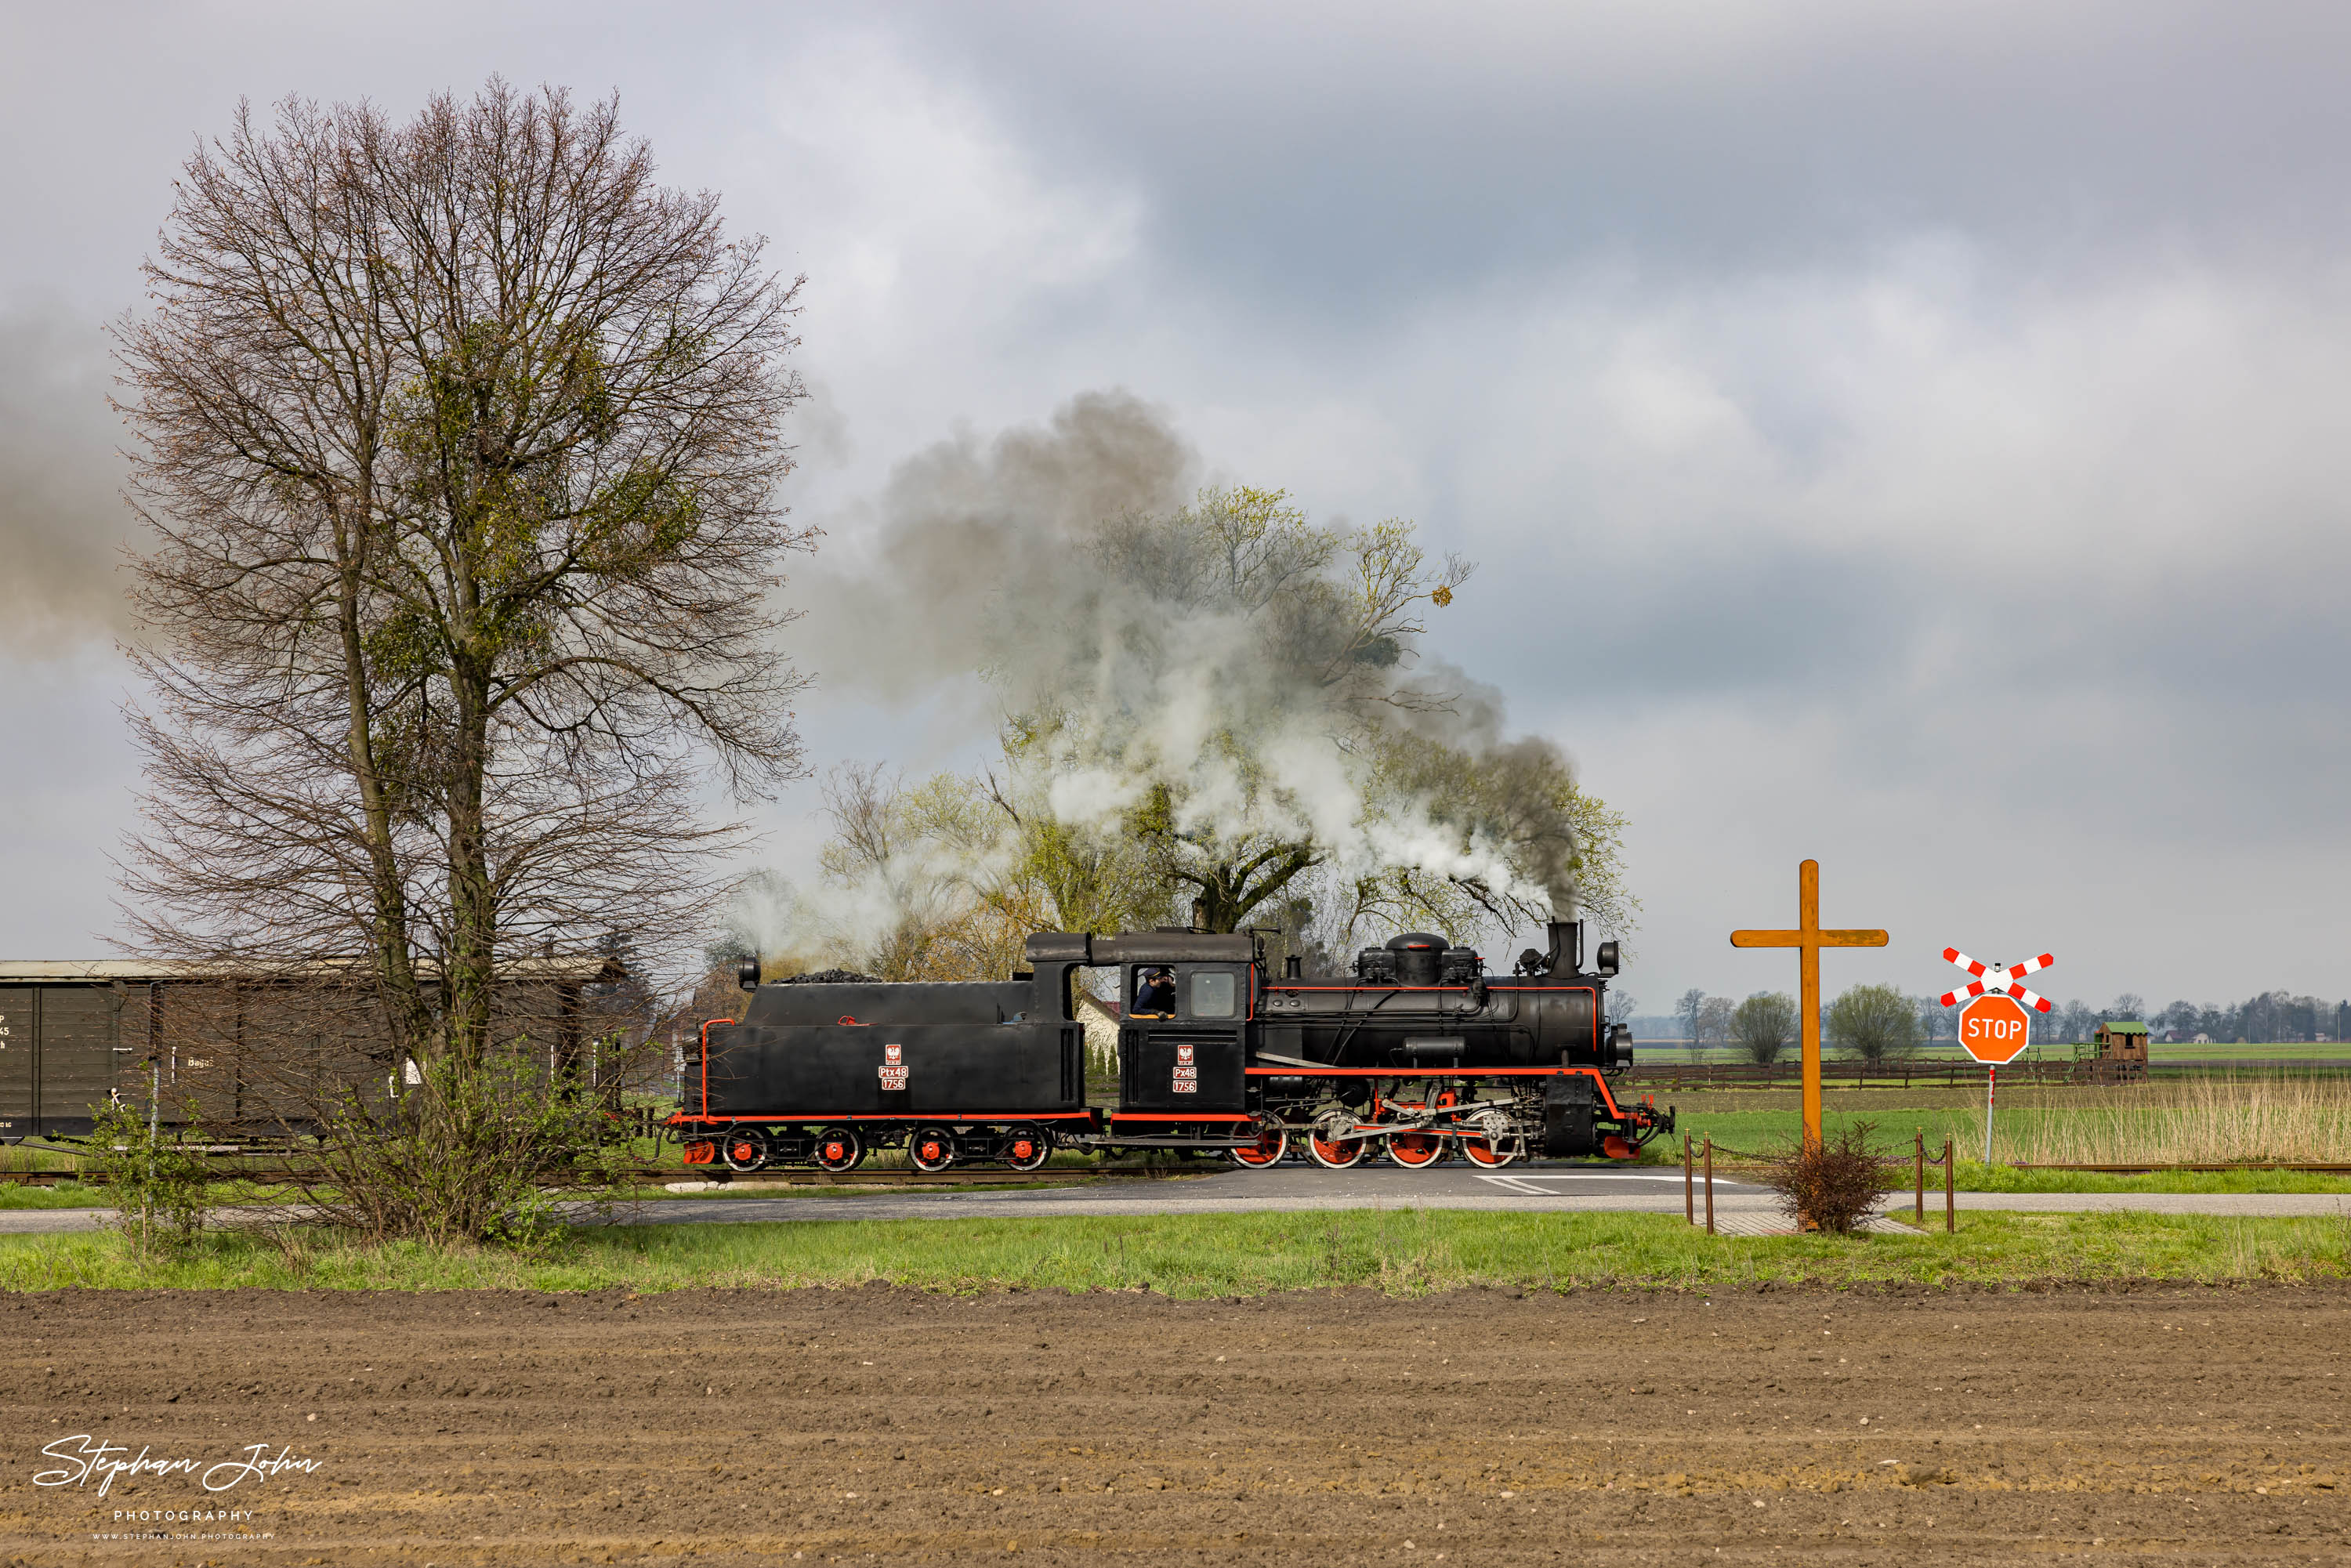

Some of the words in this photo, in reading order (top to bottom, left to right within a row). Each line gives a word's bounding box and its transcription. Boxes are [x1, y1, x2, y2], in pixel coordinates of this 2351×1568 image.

[1968, 1018, 2022, 1040] STOP
[880, 1068, 907, 1077] Ptx48
[1176, 1068, 1195, 1077] Px48
[883, 1079, 904, 1088] 1756
[1175, 1081, 1195, 1092] 1756
